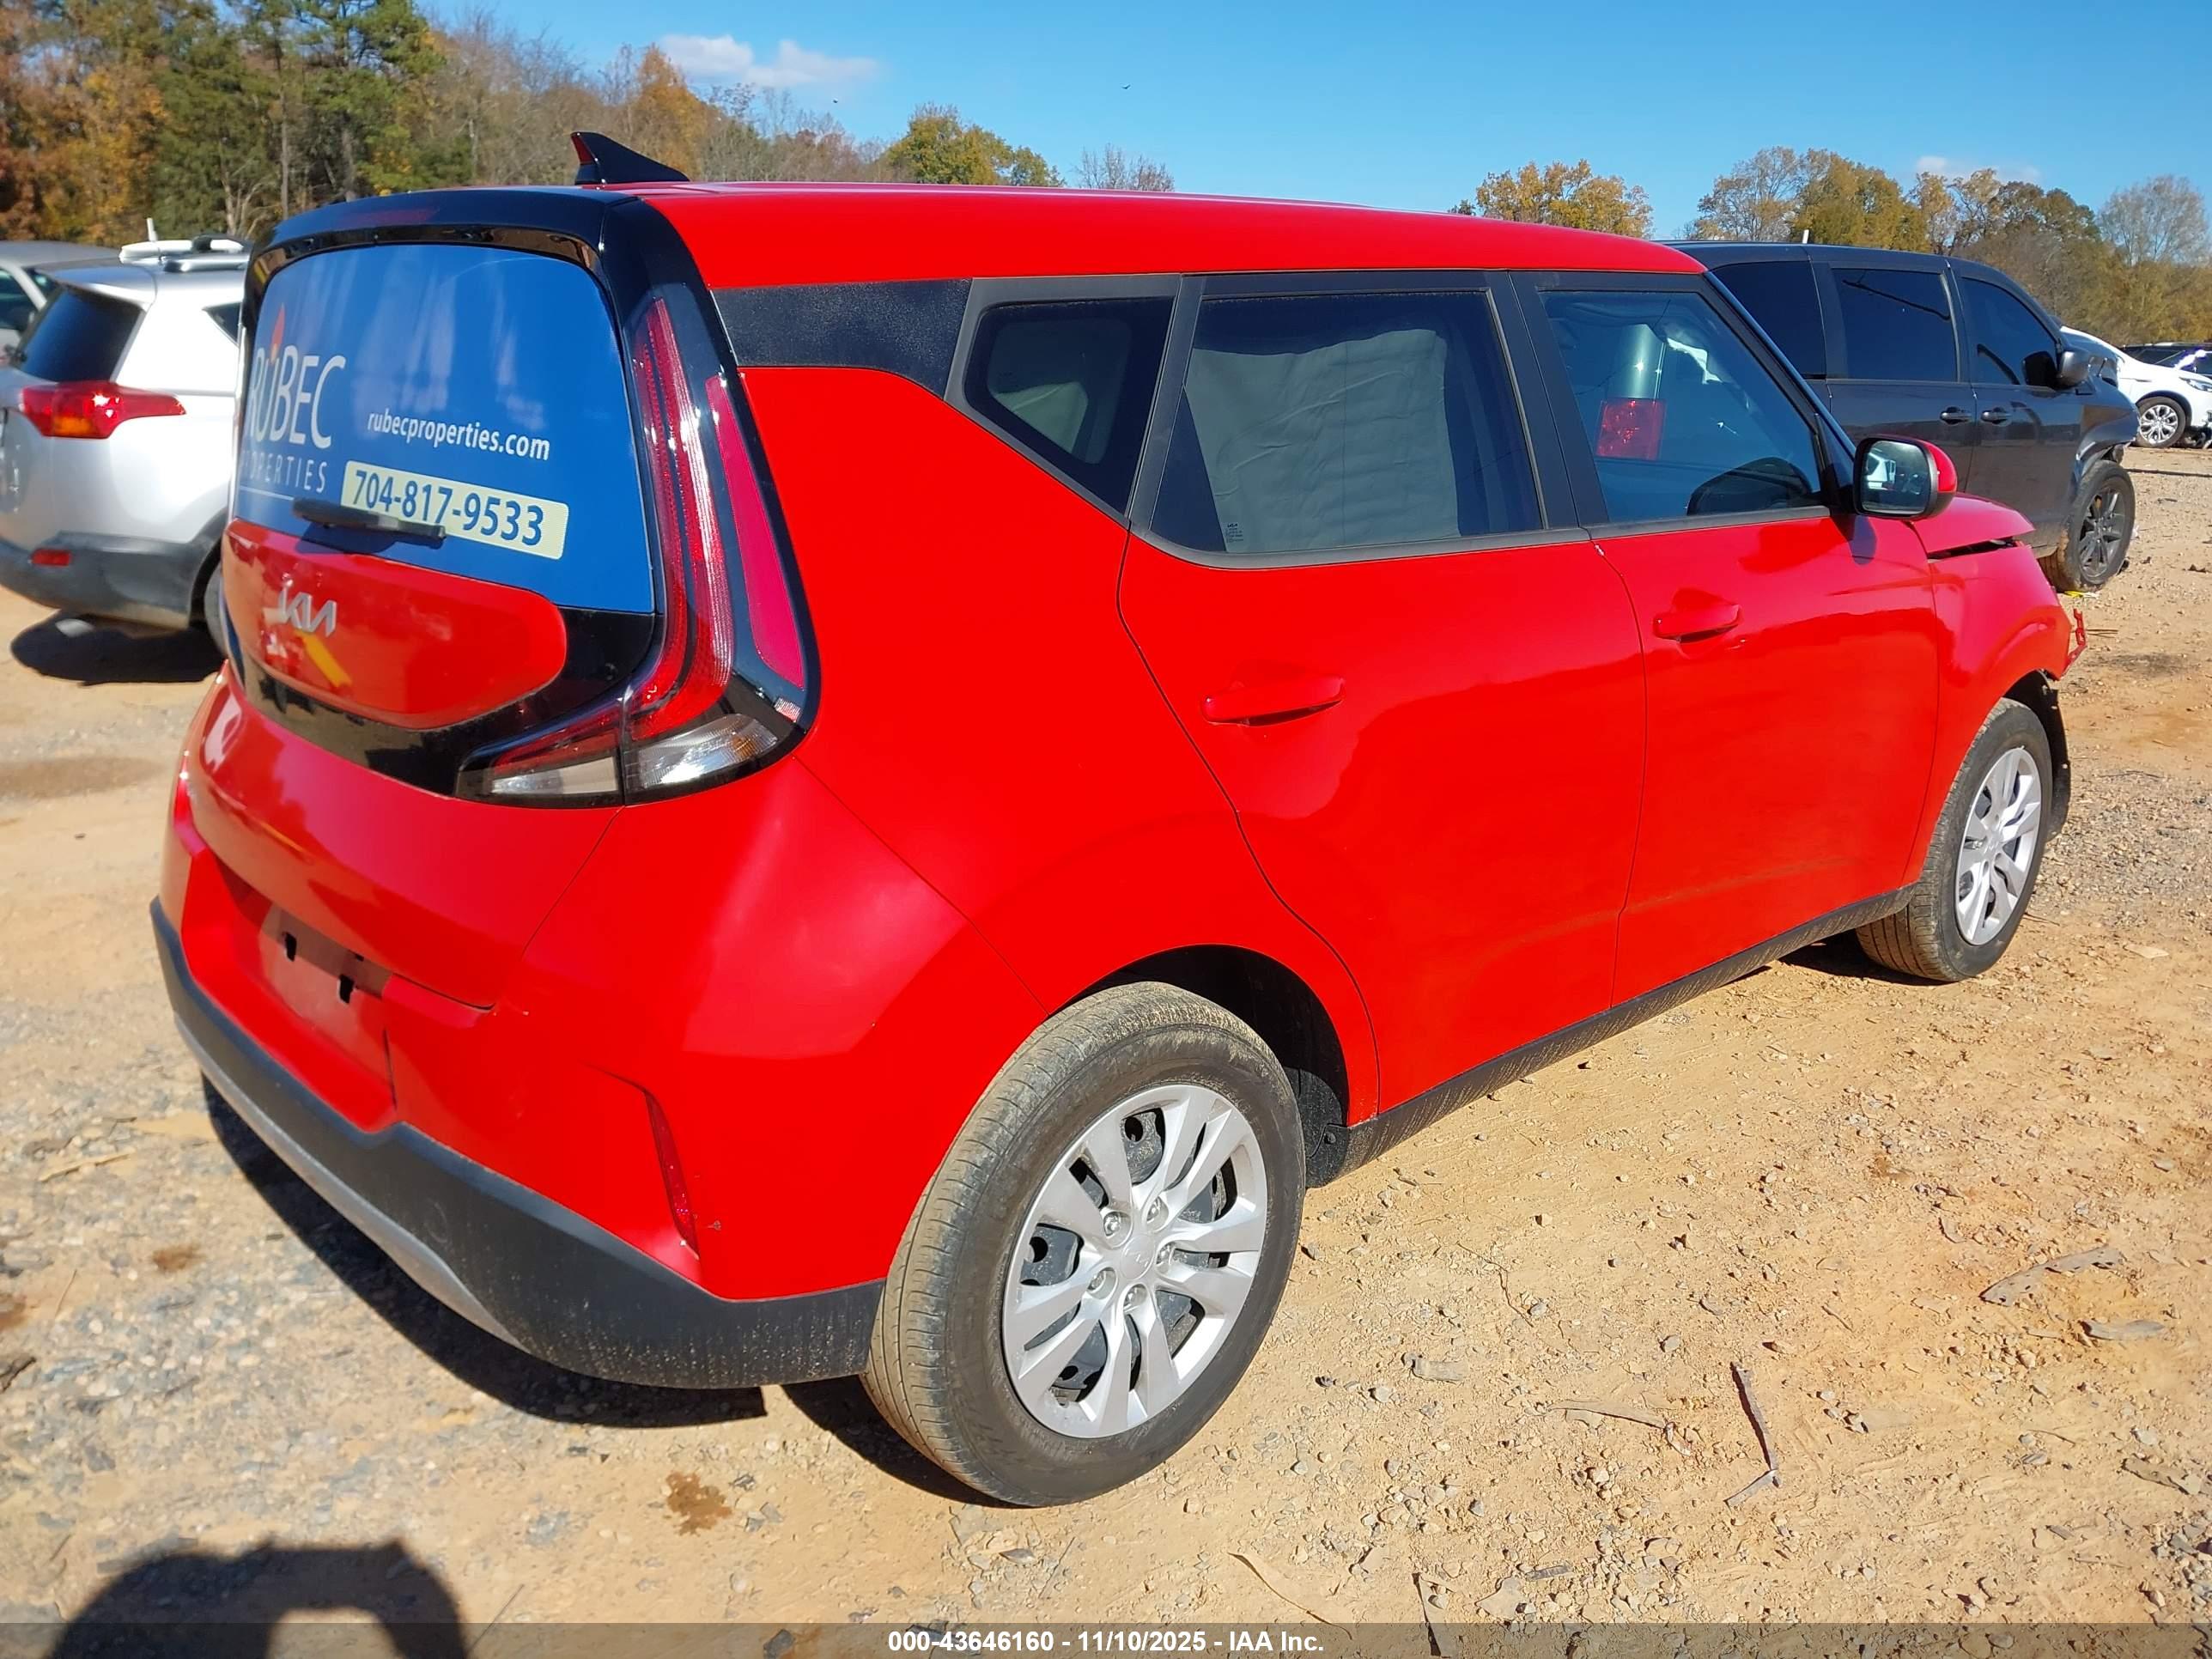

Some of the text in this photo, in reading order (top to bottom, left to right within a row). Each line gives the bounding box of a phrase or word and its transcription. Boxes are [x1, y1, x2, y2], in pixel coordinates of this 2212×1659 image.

[249, 345, 346, 449] RUBEC
[367, 410, 550, 460] rubecproperties.com
[352, 470, 544, 547] 704-817-9533
